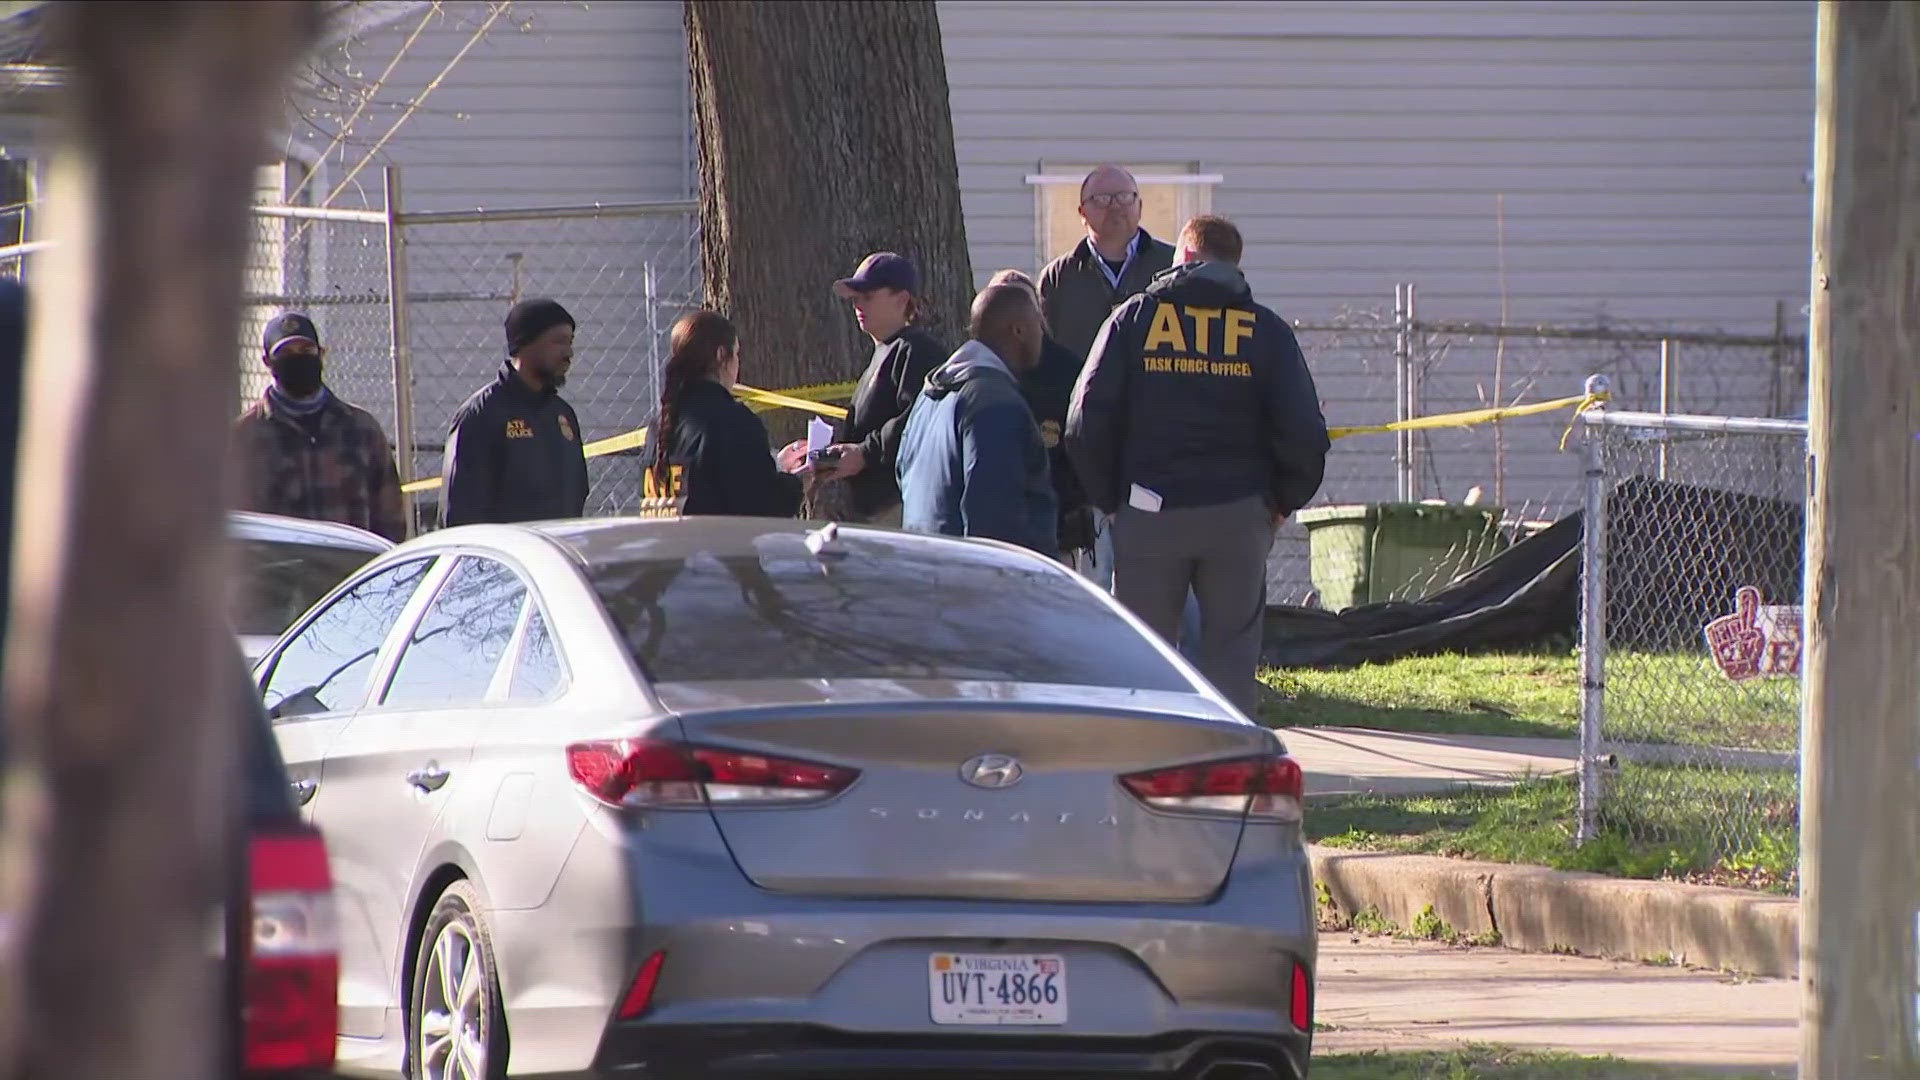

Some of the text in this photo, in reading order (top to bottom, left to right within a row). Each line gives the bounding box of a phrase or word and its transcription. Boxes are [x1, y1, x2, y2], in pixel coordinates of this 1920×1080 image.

[1144, 302, 1256, 356] ATF
[1144, 357, 1173, 373] TASK
[1174, 358, 1209, 375] FORCE
[869, 807, 1118, 826] SONATA
[965, 958, 1029, 971] VIRGINIA
[942, 972, 1059, 1005] UVT-4866
